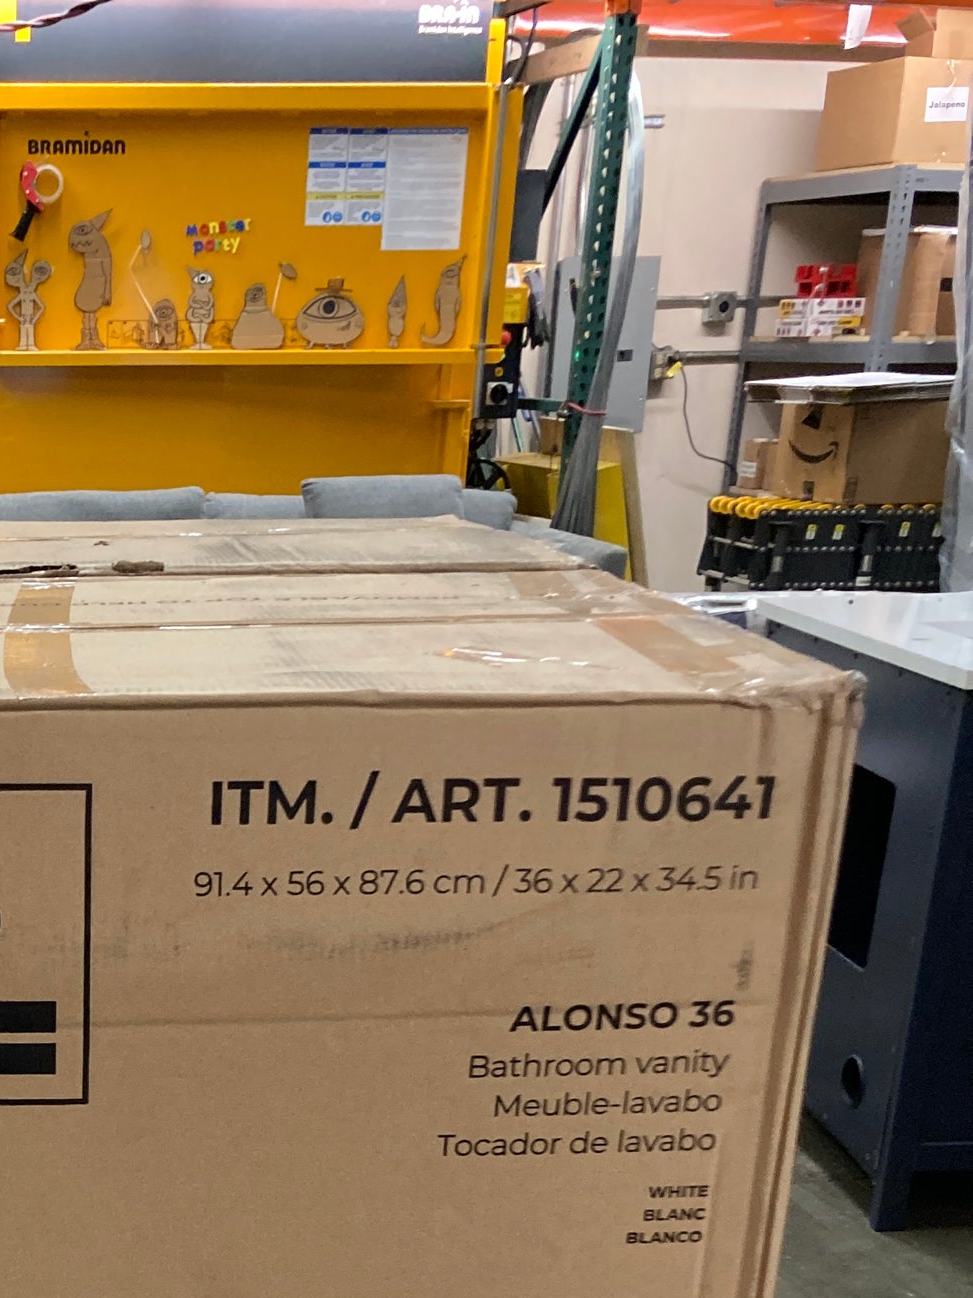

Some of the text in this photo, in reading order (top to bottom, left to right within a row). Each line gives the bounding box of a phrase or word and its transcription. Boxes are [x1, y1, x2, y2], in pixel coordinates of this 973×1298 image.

[210, 779, 333, 825] ITM.
[392, 776, 531, 823] ART.
[553, 774, 777, 822] 1510641
[193, 871, 253, 897] 91.4
[260, 877, 279, 896] x
[286, 870, 326, 896] 56
[332, 876, 352, 896] x
[359, 869, 425, 895] 87.6
[433, 873, 485, 895] cm
[514, 867, 553, 893] 36
[560, 874, 579, 893] x
[586, 867, 624, 893] 22
[631, 872, 650, 892] x
[656, 866, 722, 891] 34.5
[729, 865, 759, 890] in
[509, 1000, 735, 1034] ALONSO 36
[468, 1050, 731, 1079] Bathroom vanity
[493, 1089, 722, 1118] Meuble-lavabo
[437, 1128, 717, 1157] Tocador de lavabo
[648, 1185, 709, 1198] WHITE
[643, 1208, 706, 1221] BLANC
[626, 1231, 702, 1244] BLANCO
